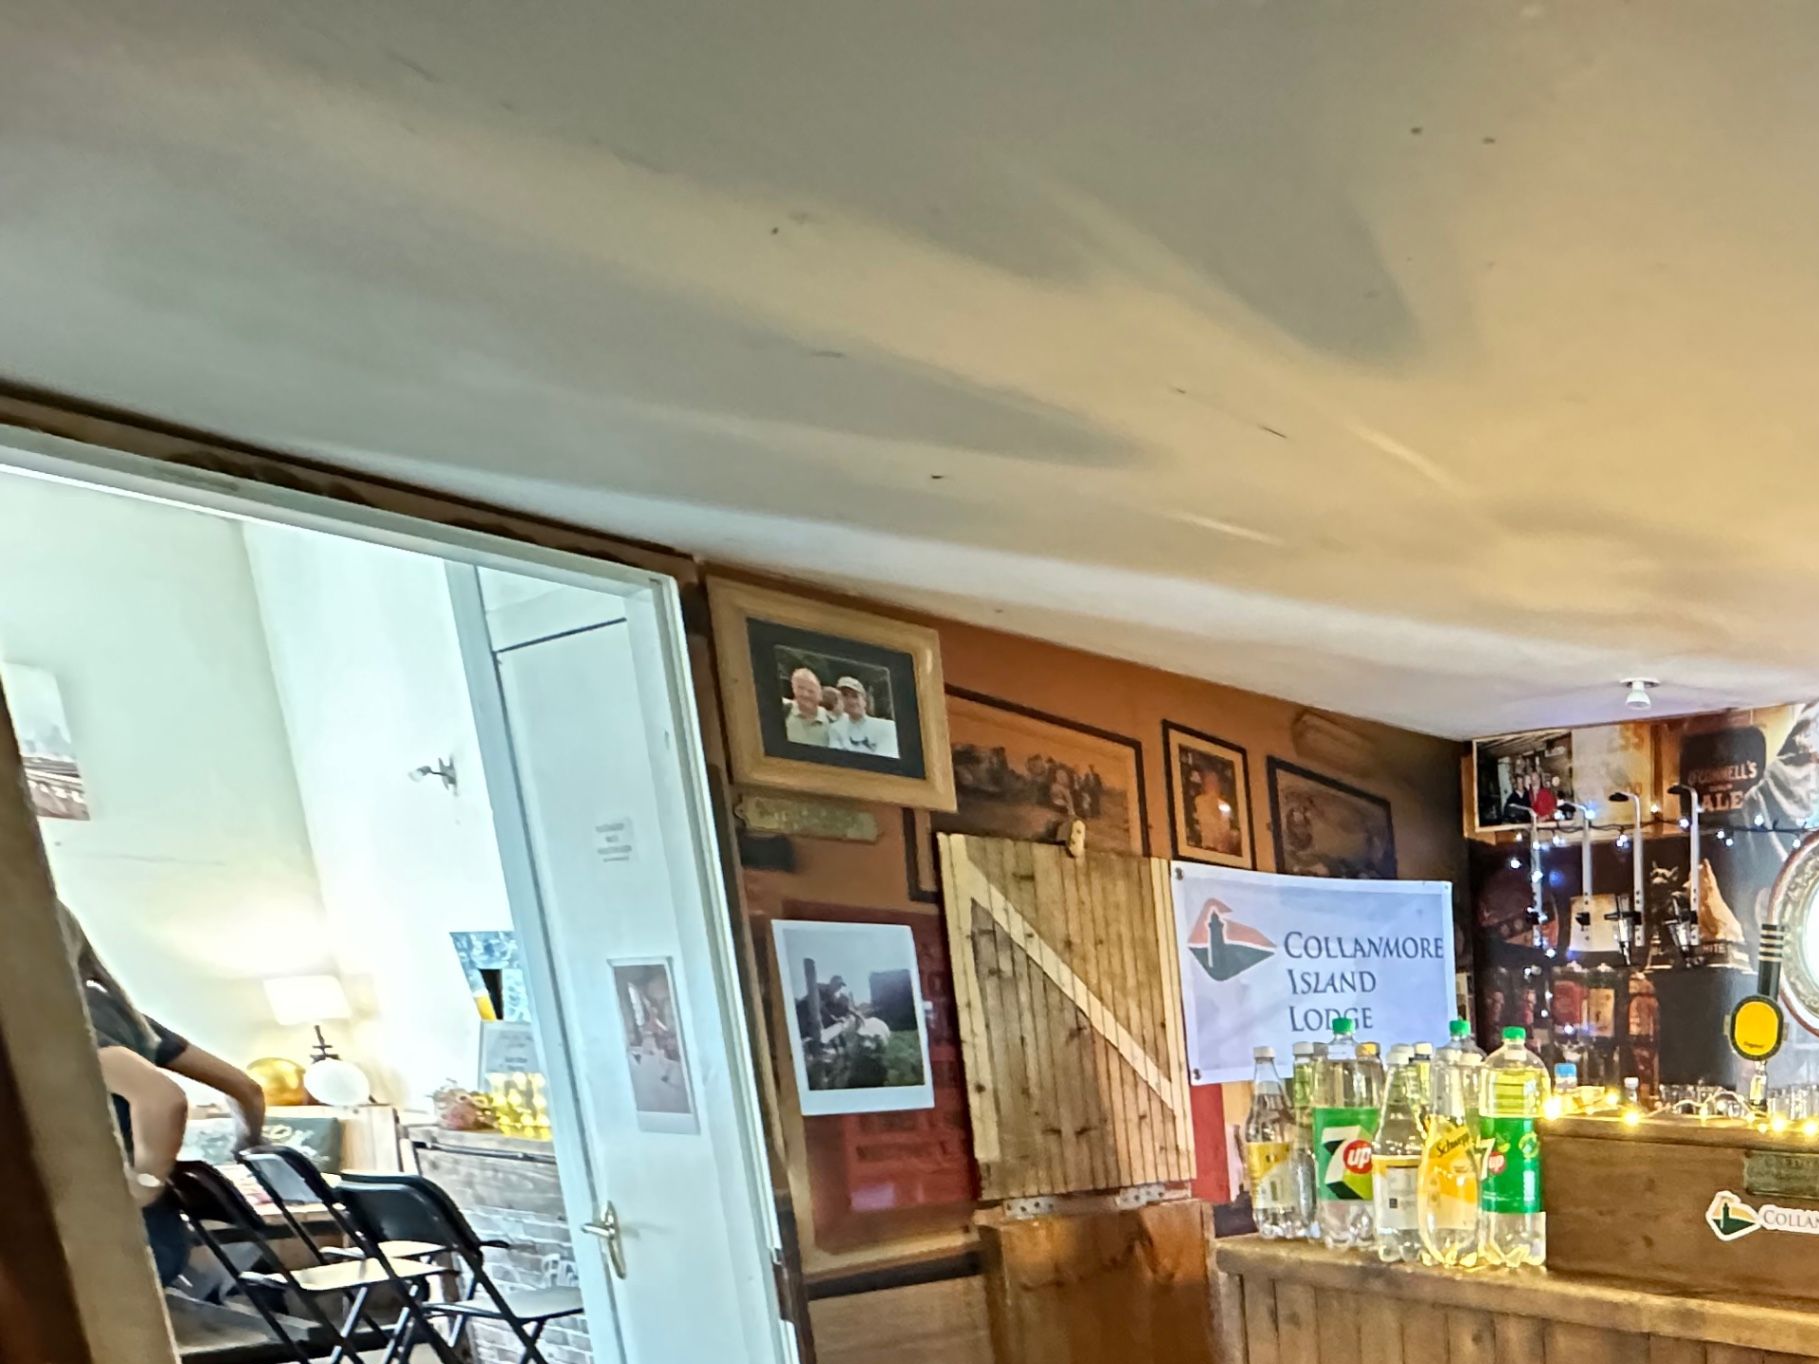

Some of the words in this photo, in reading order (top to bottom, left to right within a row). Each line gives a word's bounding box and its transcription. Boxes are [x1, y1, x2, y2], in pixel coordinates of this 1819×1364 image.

[1702, 791, 1743, 812] ALE
[1284, 932, 1444, 959] COLLANMORE
[1289, 969, 1377, 994] ISLAND
